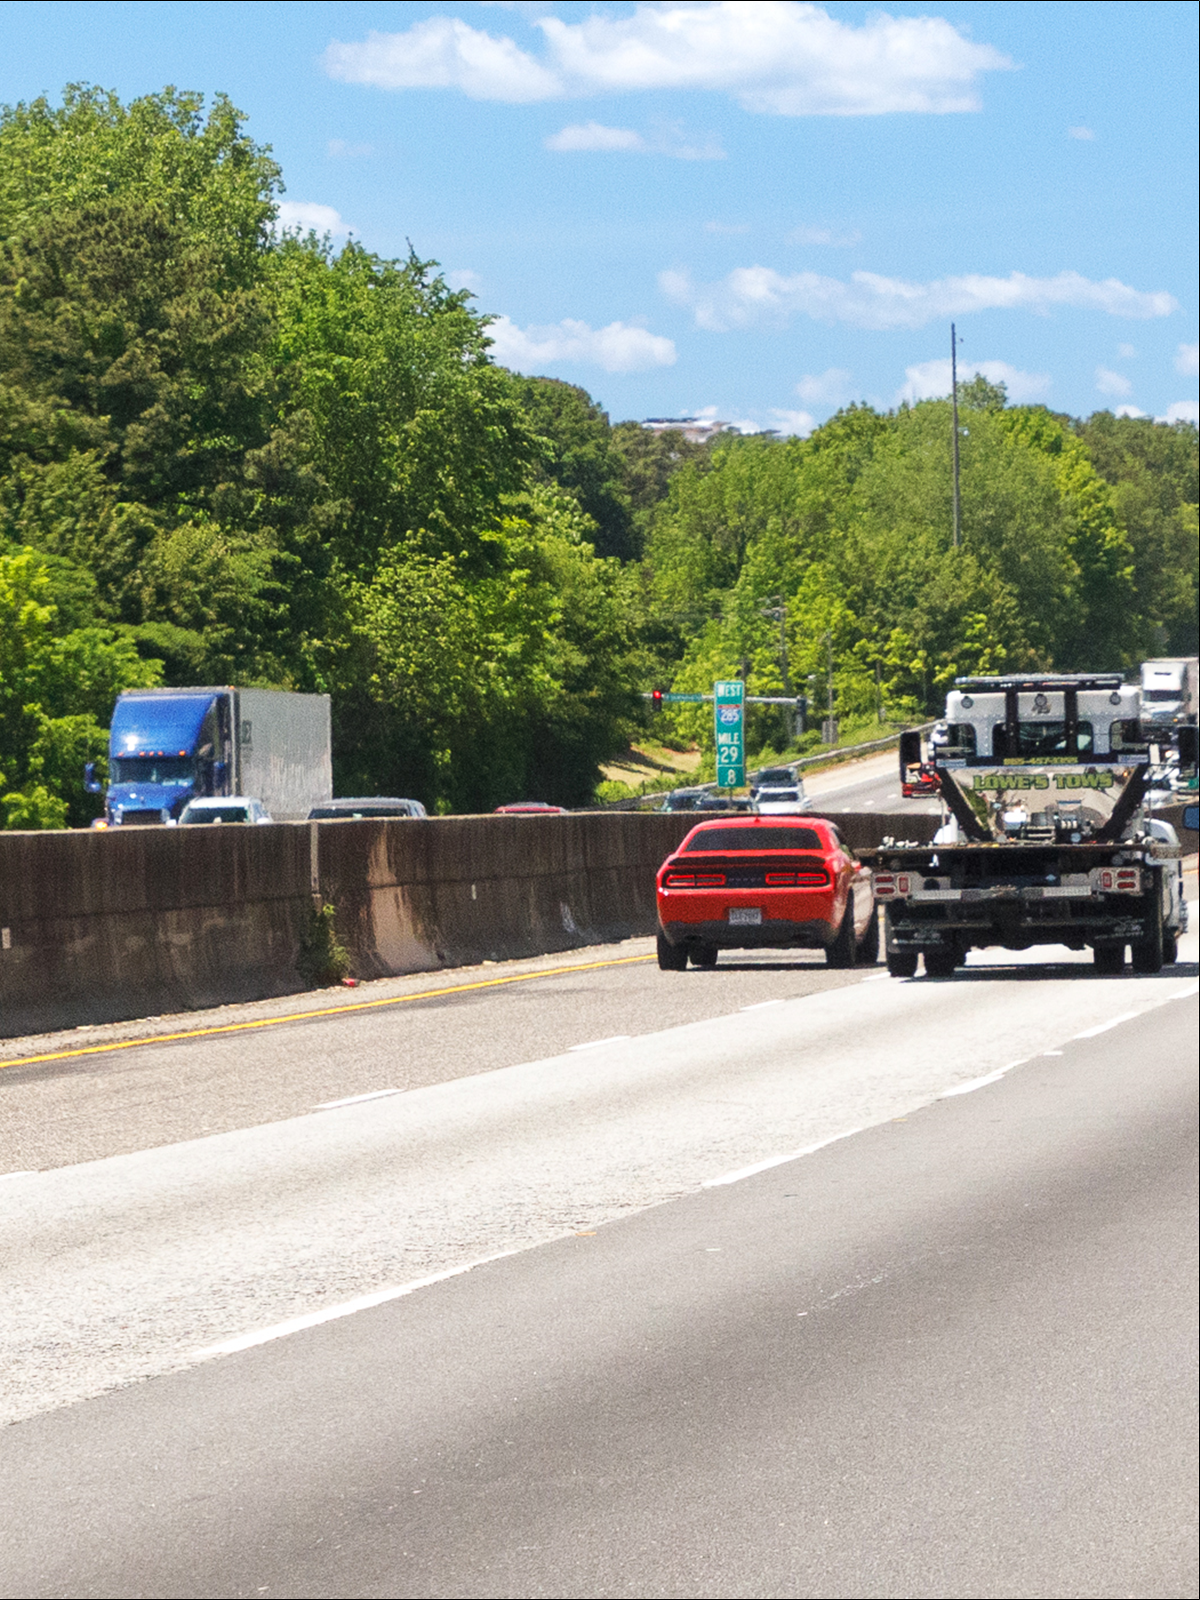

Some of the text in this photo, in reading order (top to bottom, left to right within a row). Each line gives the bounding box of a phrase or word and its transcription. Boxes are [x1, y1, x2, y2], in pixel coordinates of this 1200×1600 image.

[717, 684, 741, 697] WEST
[720, 709, 740, 721] 285
[718, 733, 740, 745] MILE
[720, 746, 738, 763] 29
[973, 773, 1113, 790] LOWE'S TOWS
